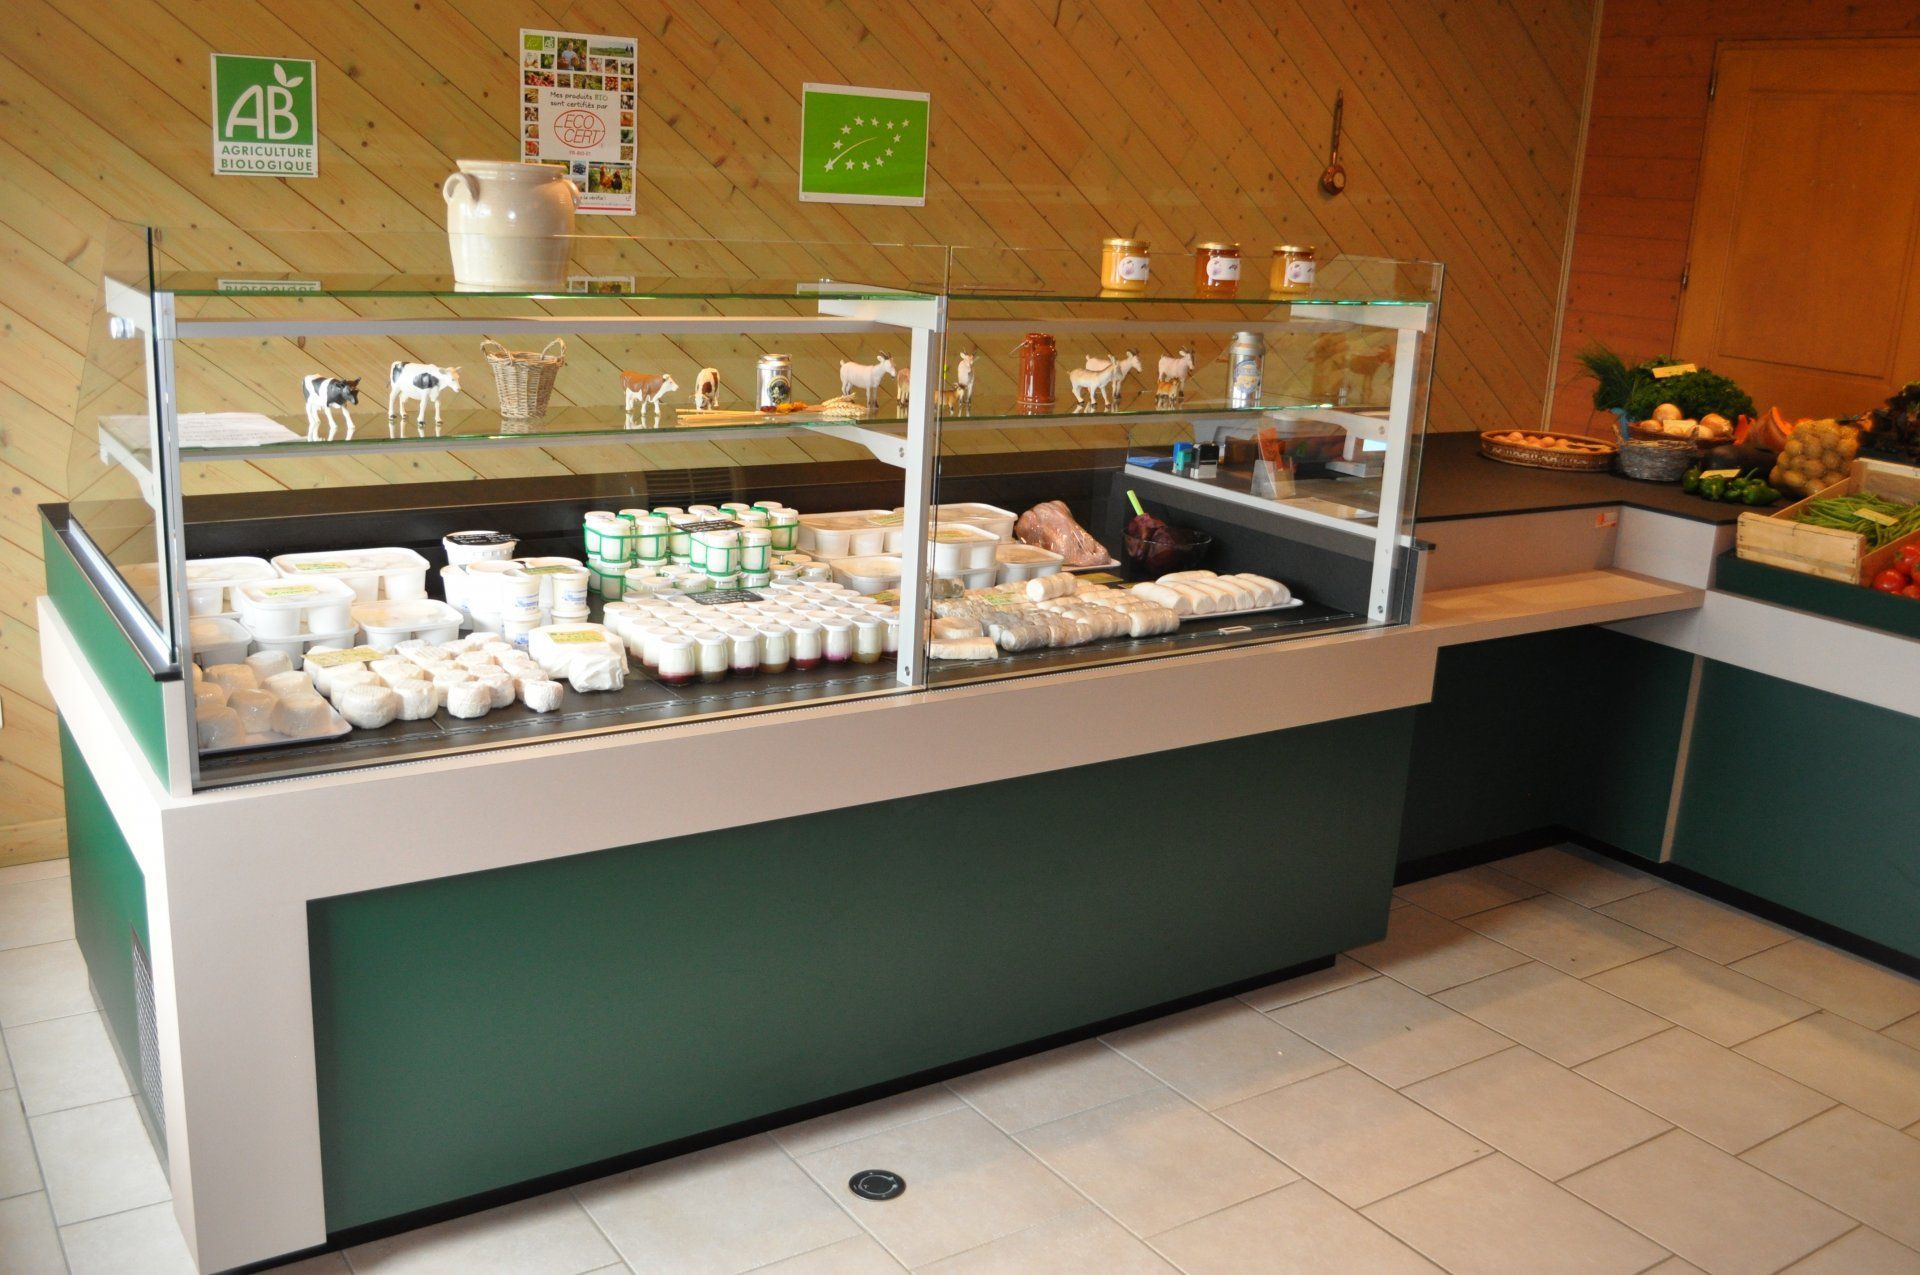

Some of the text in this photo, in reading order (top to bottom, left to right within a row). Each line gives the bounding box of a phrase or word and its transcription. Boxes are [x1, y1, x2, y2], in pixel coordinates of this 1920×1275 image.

[550, 91, 563, 99] Mes
[564, 93, 592, 101] produits
[225, 84, 299, 140] AB
[566, 101, 595, 109] certifiés
[564, 114, 595, 130] ECO
[564, 128, 602, 144] CERT
[221, 145, 312, 159] AGRICULTURE
[221, 158, 312, 172] BIOLOGIQUE
